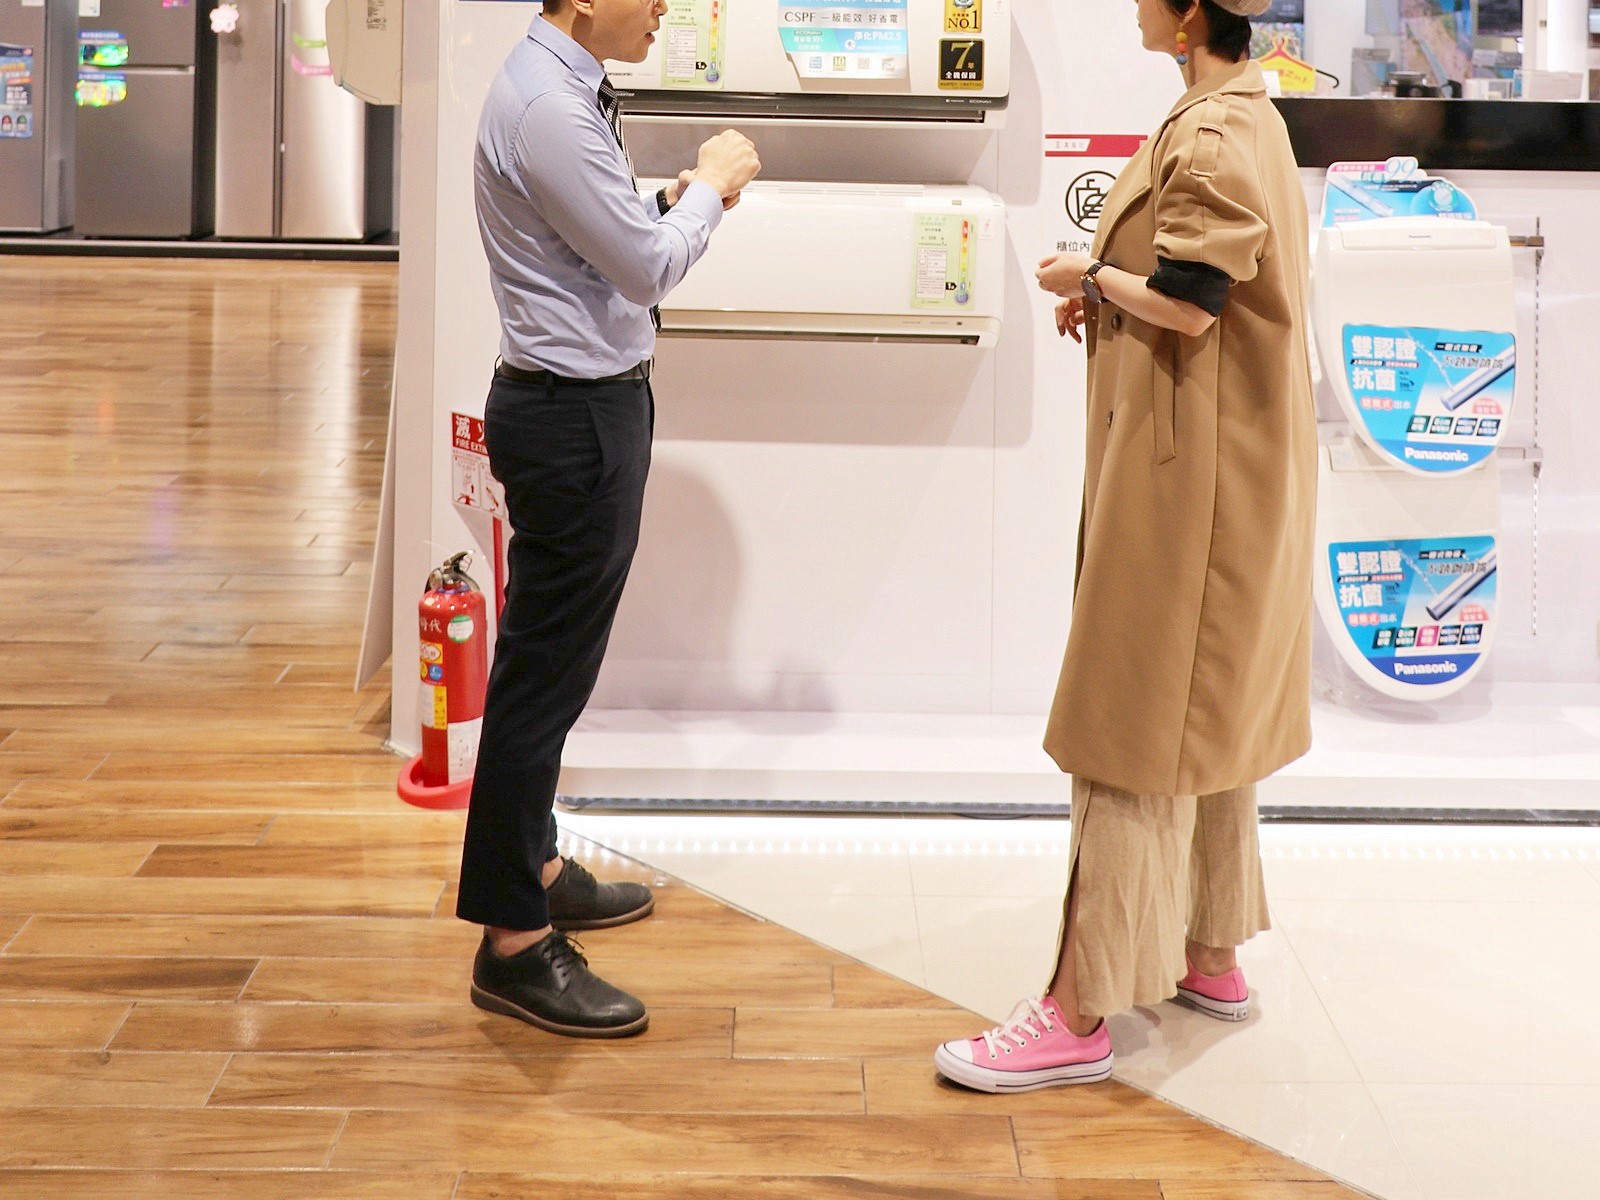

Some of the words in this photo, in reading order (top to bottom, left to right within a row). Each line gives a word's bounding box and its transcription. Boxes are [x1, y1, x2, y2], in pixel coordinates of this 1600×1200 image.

[784, 11, 816, 22] CSPF
[1352, 367, 1396, 391] 抗菌
[455, 437, 470, 449] FIRE
[1405, 447, 1469, 462] Panasonic
[1340, 584, 1382, 608] 抗菌
[1394, 661, 1458, 675] Panasonic
